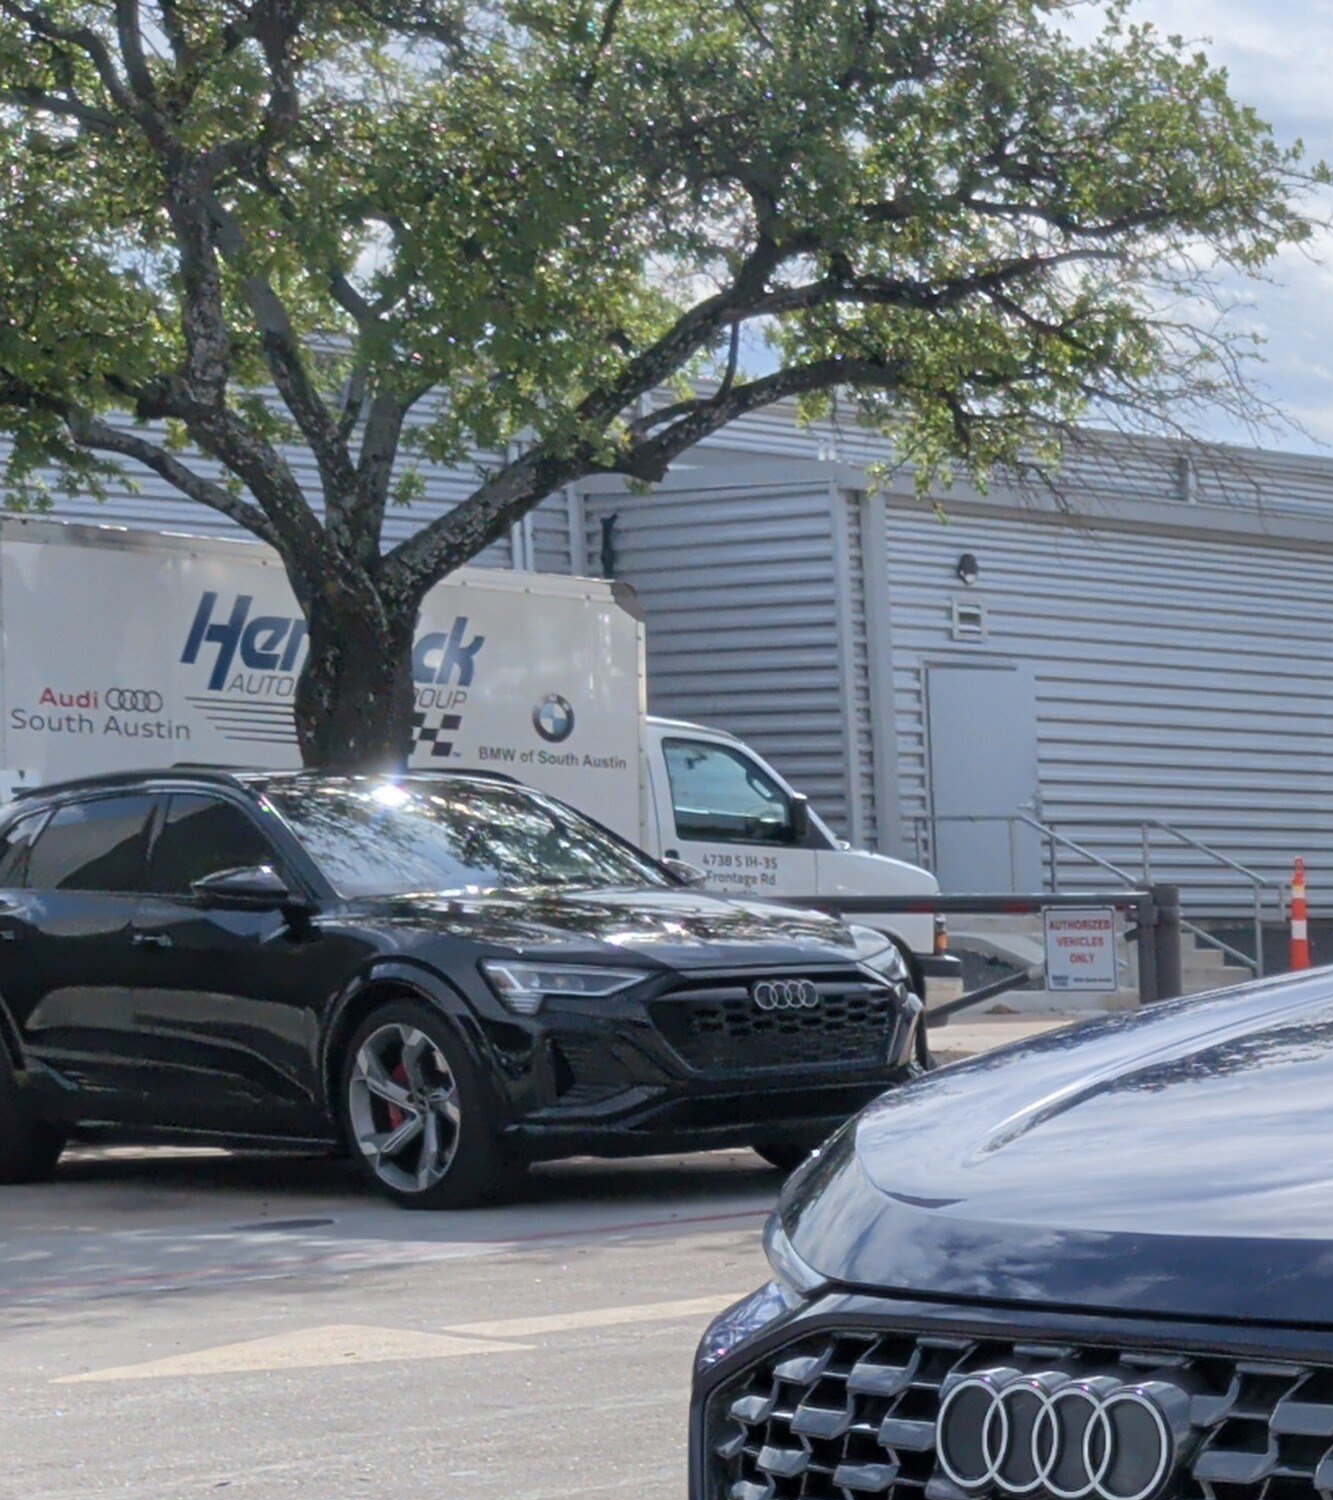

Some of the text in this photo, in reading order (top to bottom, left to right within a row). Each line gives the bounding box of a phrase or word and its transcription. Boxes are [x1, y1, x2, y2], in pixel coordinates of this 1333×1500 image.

[39, 687, 99, 709] Audi
[10, 708, 191, 740] South Austin
[478, 747, 627, 770] BMW of South Austin
[705, 870, 776, 887] Frontage Rd
[1049, 919, 1111, 931] AUTHORIZED
[1057, 936, 1104, 947] VEHICLES
[1069, 953, 1095, 964] ONLY
